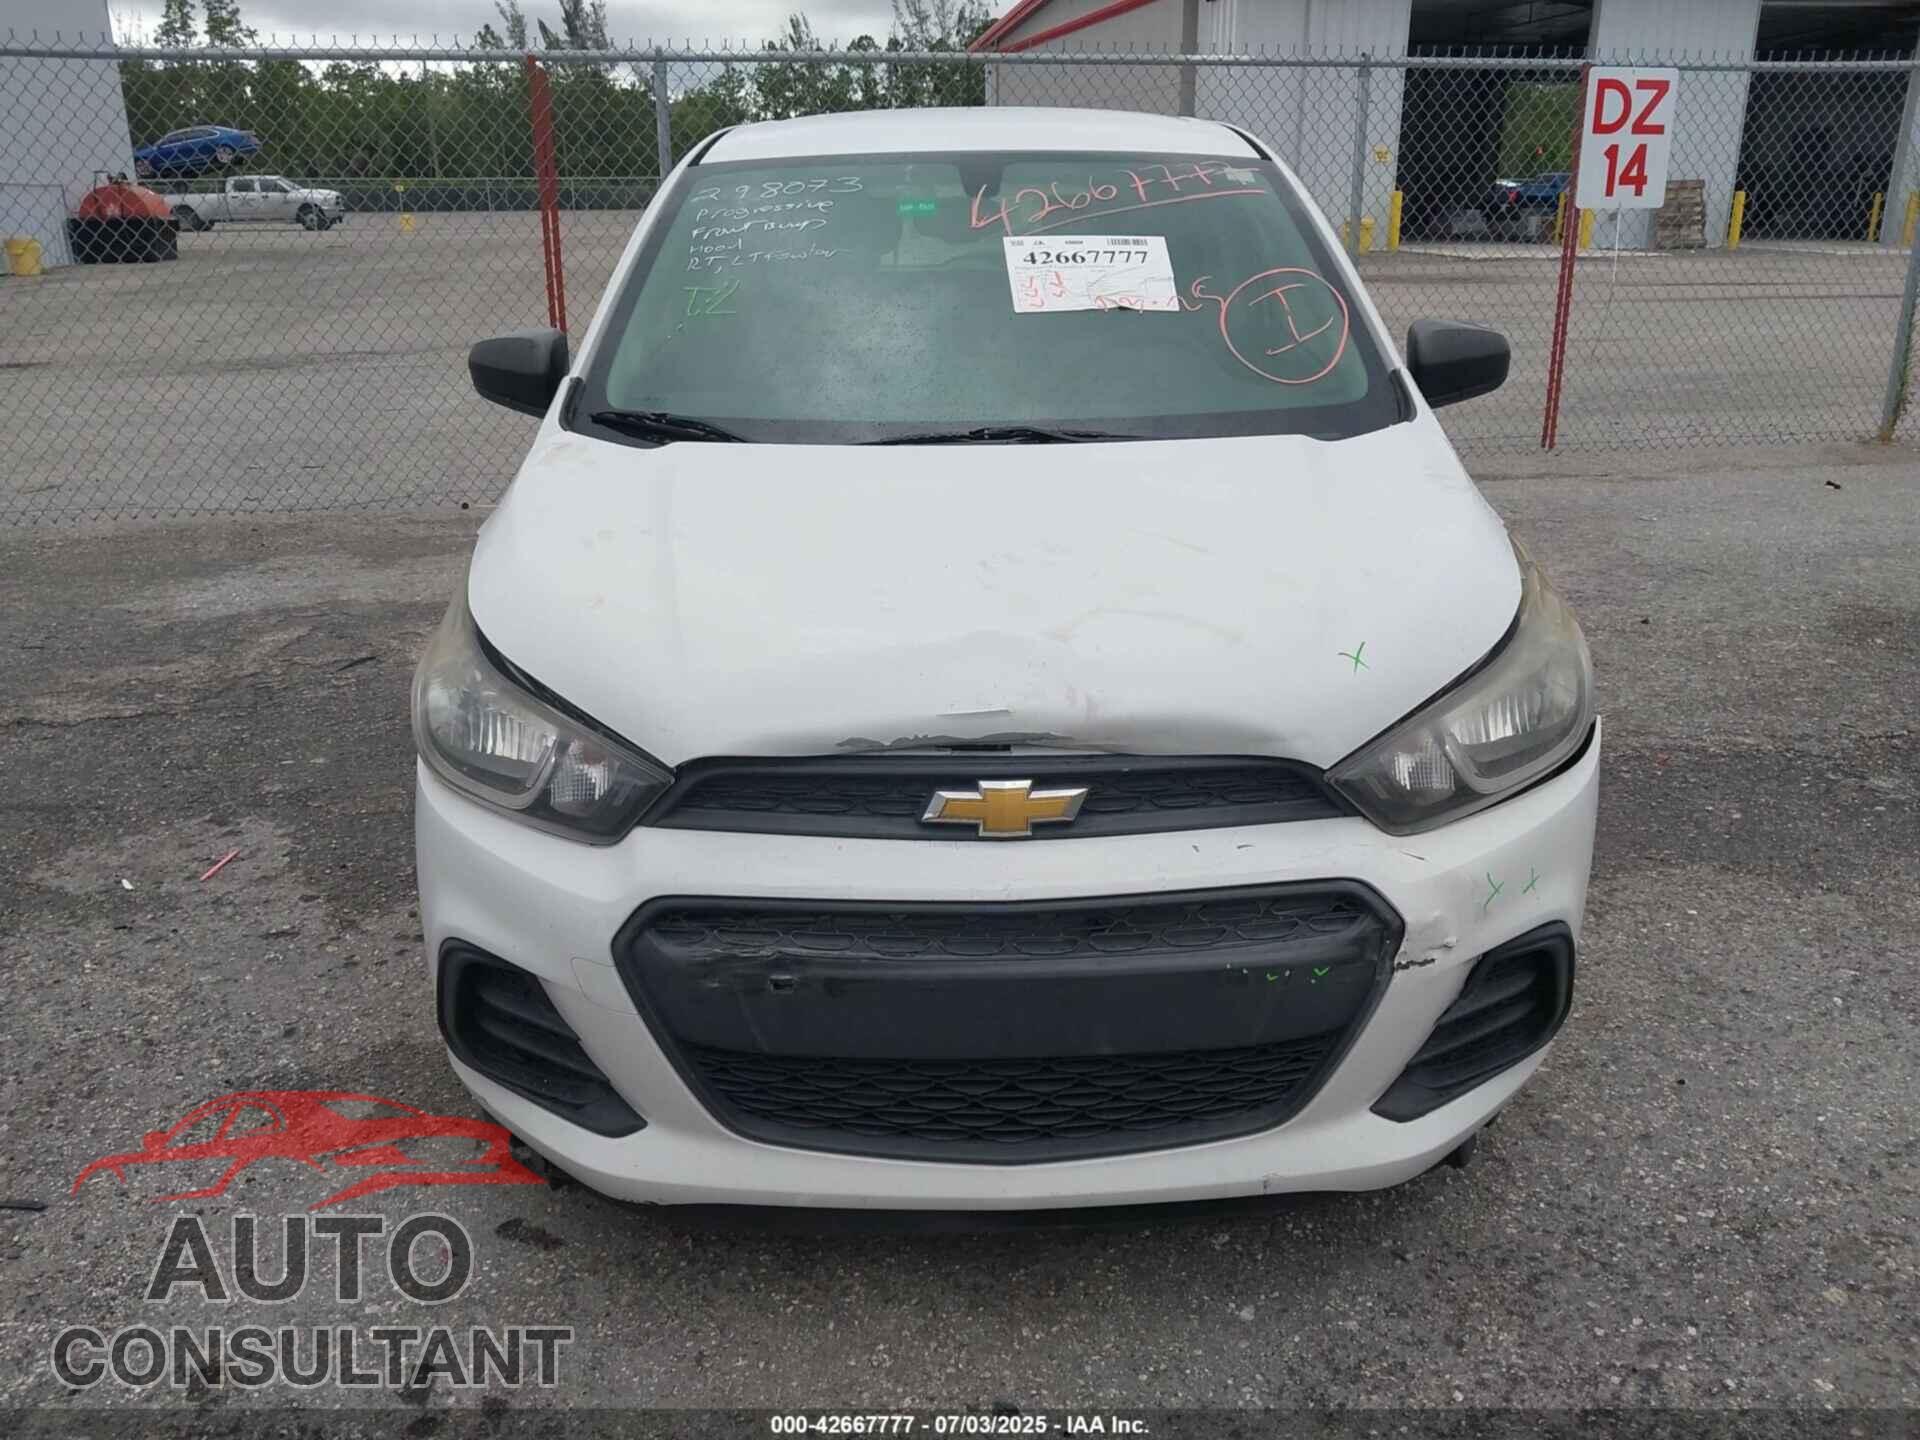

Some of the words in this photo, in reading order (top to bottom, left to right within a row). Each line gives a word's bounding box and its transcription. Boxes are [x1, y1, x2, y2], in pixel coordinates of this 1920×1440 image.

[1592, 79, 1670, 135] DZ
[1604, 143, 1648, 197] 14
[1023, 250, 1148, 265] 42667777
